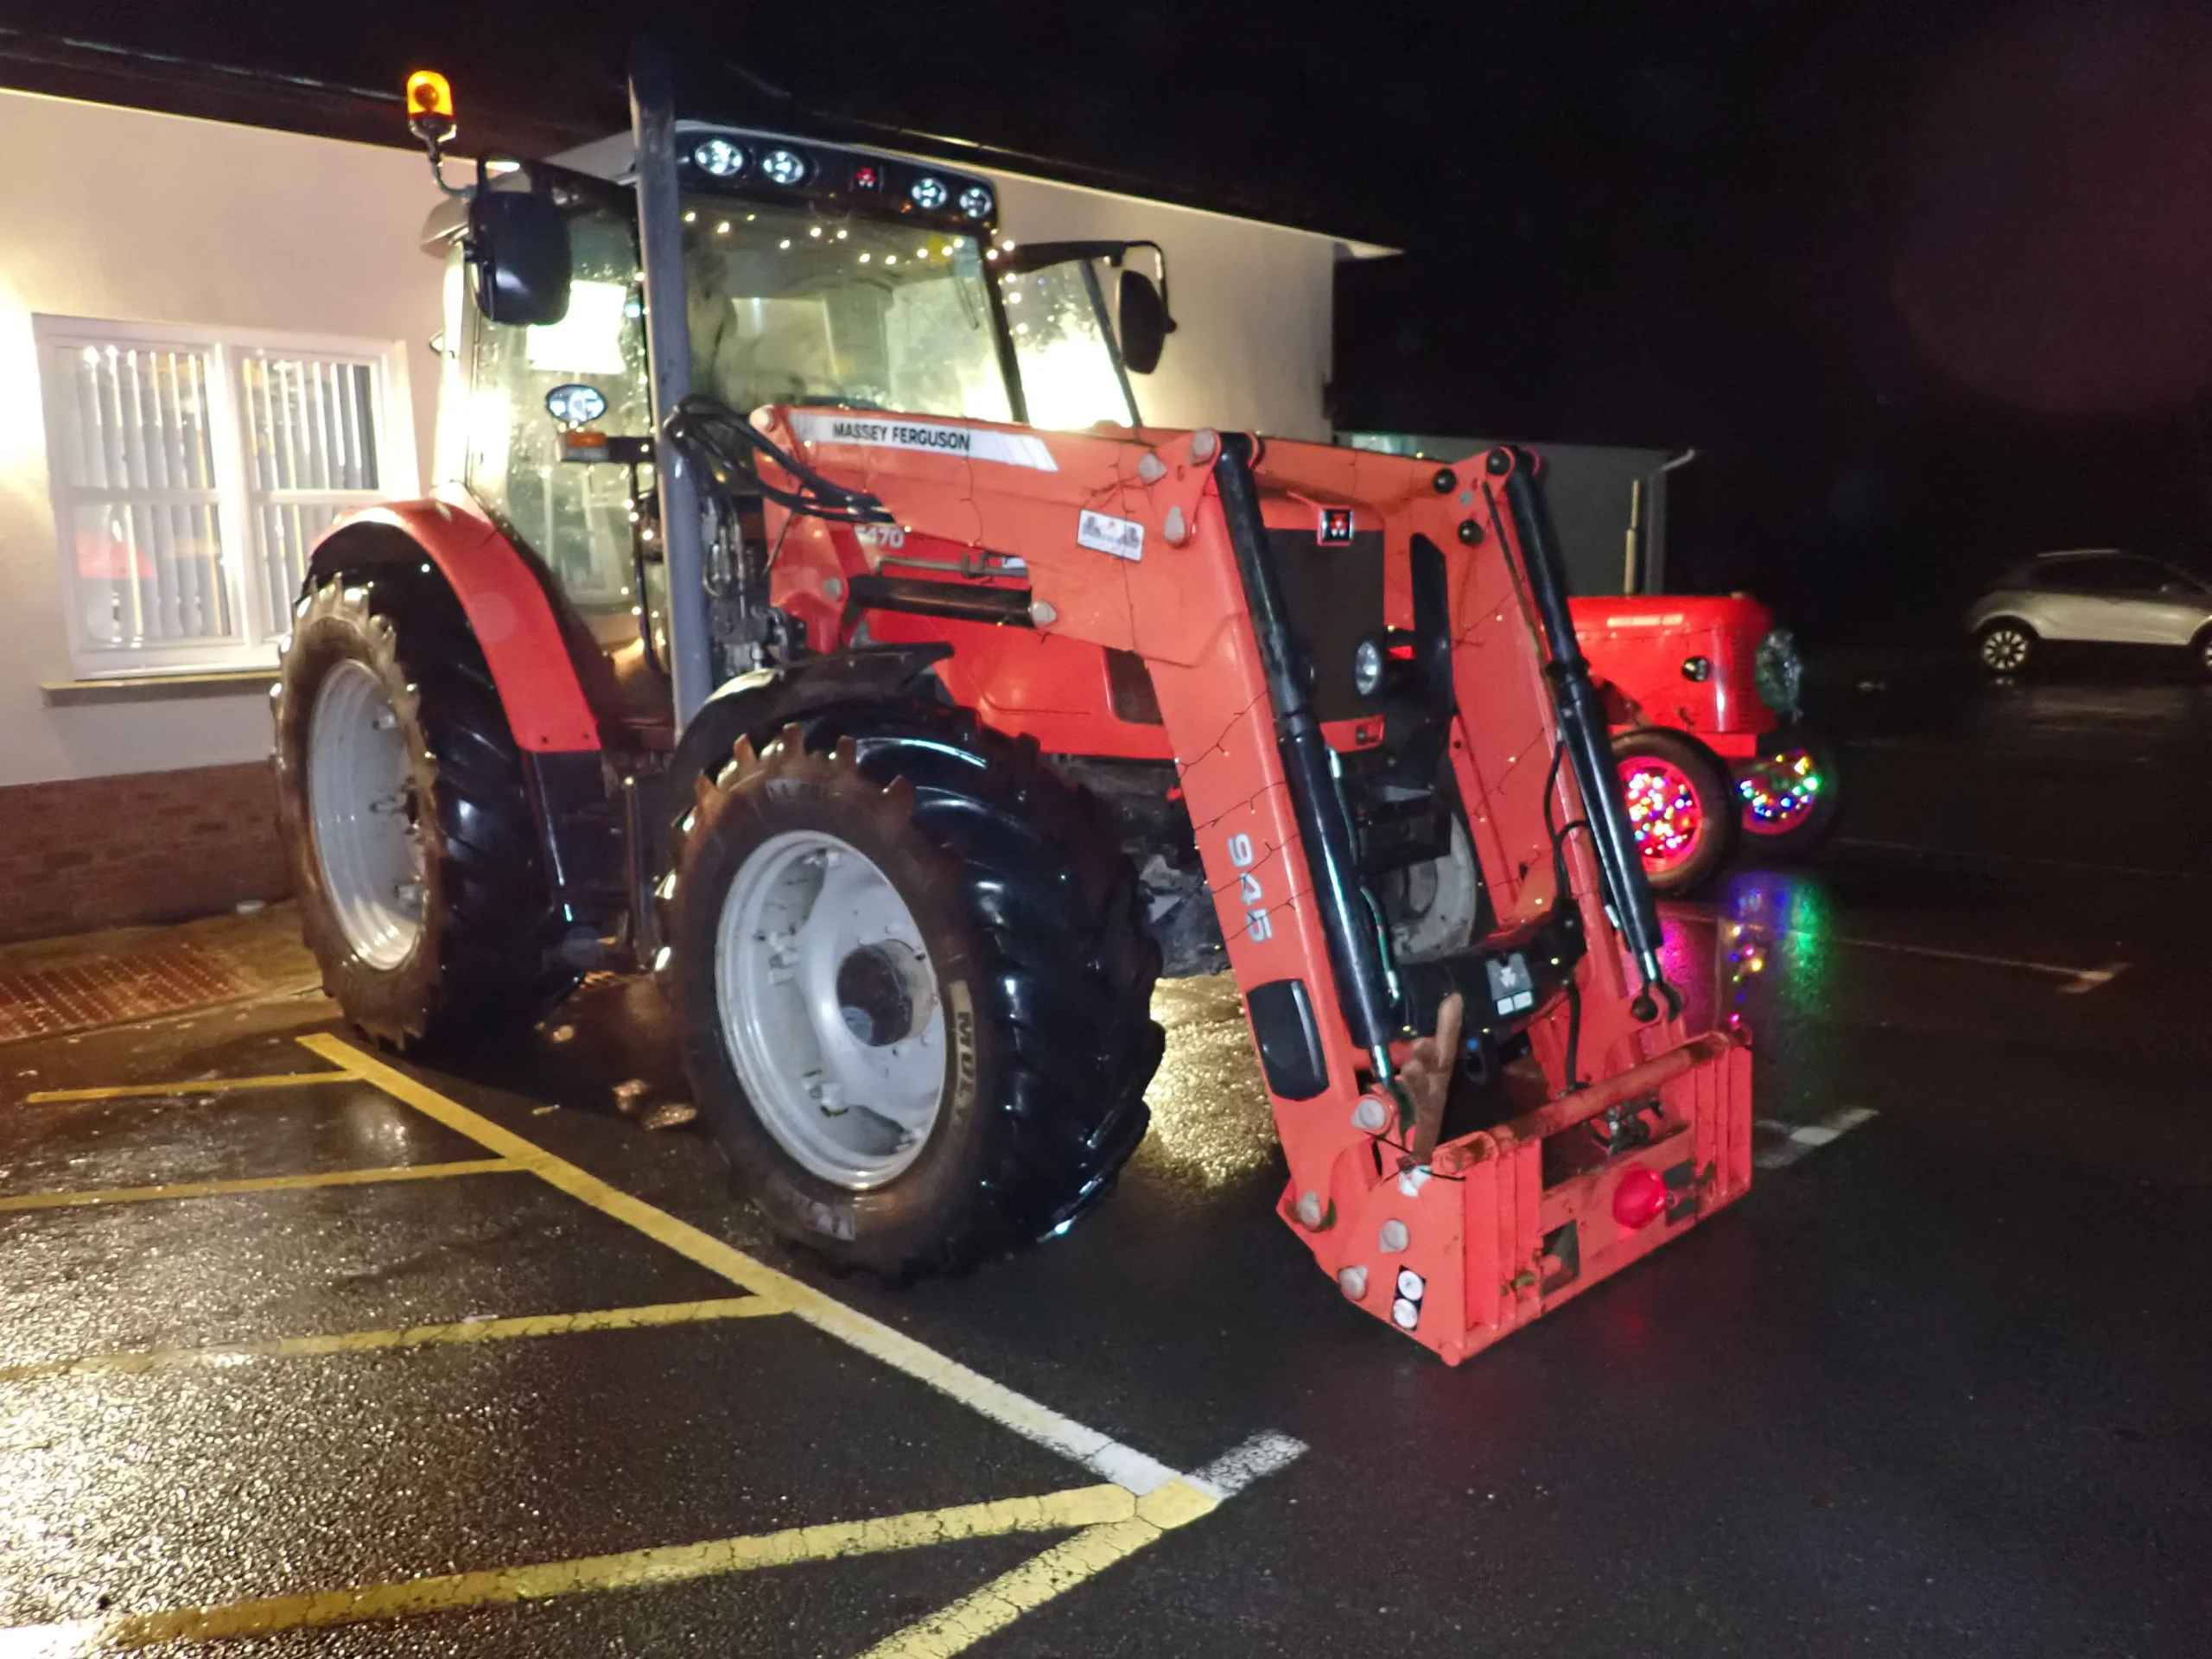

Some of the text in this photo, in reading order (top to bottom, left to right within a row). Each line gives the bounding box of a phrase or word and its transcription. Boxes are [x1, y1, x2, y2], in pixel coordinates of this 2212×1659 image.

[834, 423, 970, 452] MASSEY FERGUSON
[1227, 834, 1273, 942] 945
